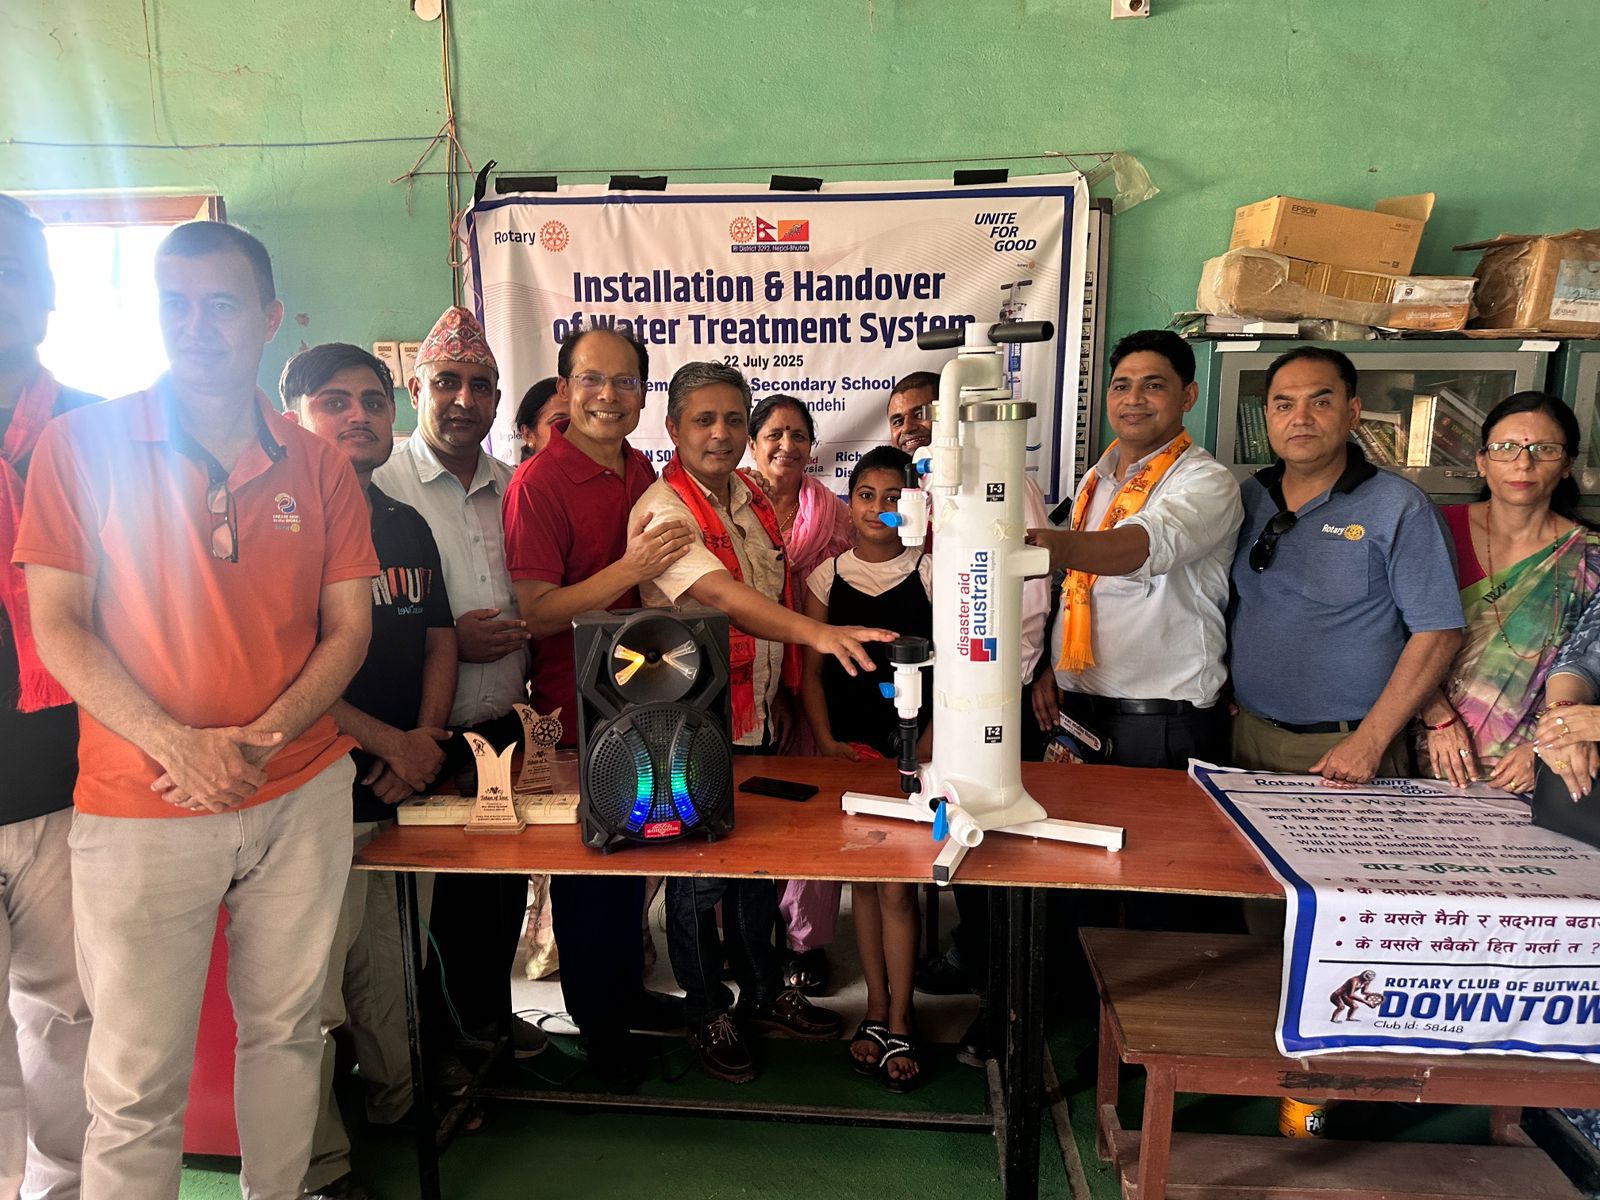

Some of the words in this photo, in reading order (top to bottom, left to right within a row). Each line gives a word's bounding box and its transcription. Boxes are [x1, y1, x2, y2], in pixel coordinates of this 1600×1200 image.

[1291, 204, 1318, 215] EPSON
[975, 212, 1017, 225] UNITE
[494, 231, 536, 245] Rotary
[990, 226, 1019, 239] FOR
[994, 239, 1037, 252] GOOD
[573, 269, 754, 303] Installation
[764, 271, 784, 301] &
[793, 267, 946, 301] Handover
[553, 312, 583, 344] of
[688, 313, 851, 345] Treatment
[724, 356, 738, 368] 22
[742, 355, 769, 370] July
[773, 354, 804, 367] 2025
[751, 377, 836, 394] Secondary
[841, 376, 896, 391] School
[806, 397, 846, 412] ndehi
[836, 451, 862, 462] Rich
[989, 484, 1003, 493] T-3
[1321, 524, 1345, 535] Rotary
[958, 573, 970, 595] aid
[970, 551, 988, 636] australia
[957, 599, 969, 656] disaster
[987, 727, 1001, 736] T-2
[1254, 778, 1315, 787] Rotary
[1292, 796, 1333, 804] The
[1394, 834, 1481, 843] Concerned?
[1375, 849, 1453, 857] Beneficial
[1500, 853, 1578, 861] concerned
[1501, 844, 1574, 853] friendship?
[1359, 909, 1376, 924] के
[1384, 910, 1427, 926] यसले
[1435, 909, 1469, 926] मैत्री
[1477, 914, 1491, 928] र
[1499, 915, 1558, 931] सद्भाव
[1565, 916, 1600, 929] बढा
[1355, 935, 1372, 950] के
[1380, 936, 1422, 951] यसले
[1430, 936, 1479, 952] सबैको
[1487, 937, 1518, 953] हित
[1568, 942, 1582, 953] त
[1590, 942, 1600, 954] ?
[1385, 978, 1453, 989] ROTARY
[1457, 978, 1499, 989] CLUB
[1506, 980, 1528, 991] OF
[1533, 980, 1600, 992] BUTWAL
[1374, 1020, 1401, 1030] Club
[1404, 1020, 1419, 1030] Id:
[1423, 1022, 1464, 1034] 58448
